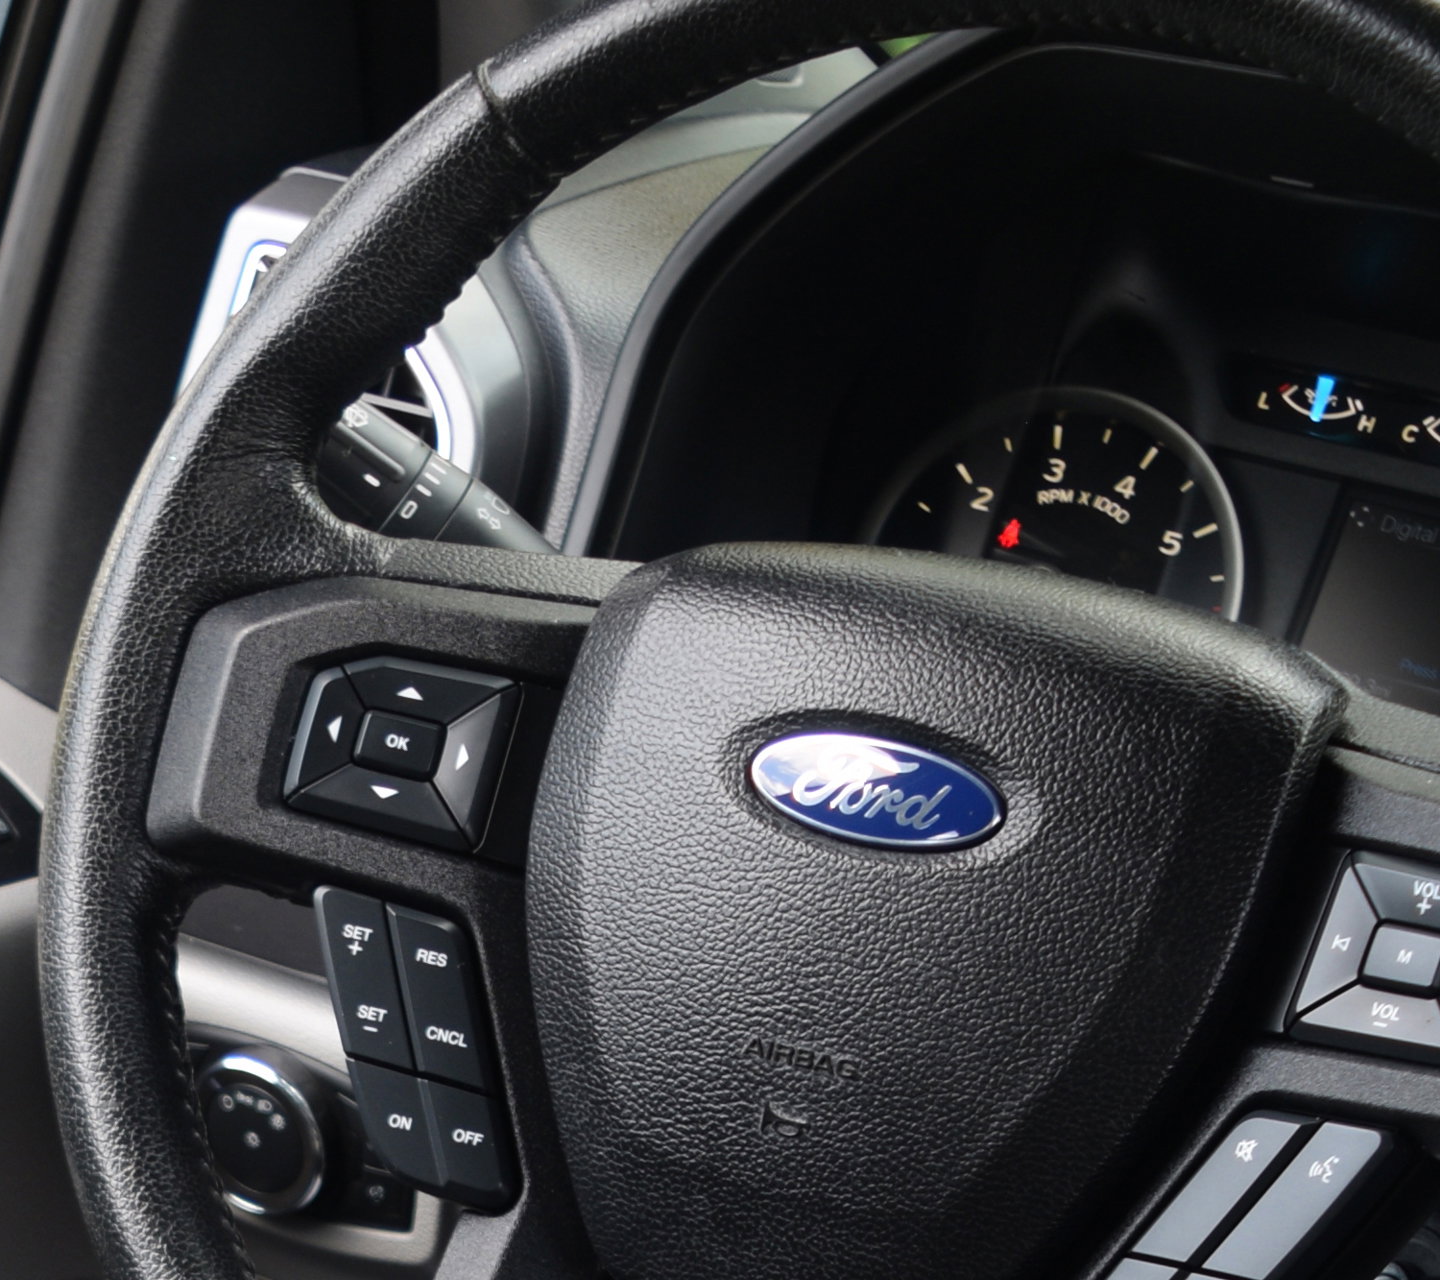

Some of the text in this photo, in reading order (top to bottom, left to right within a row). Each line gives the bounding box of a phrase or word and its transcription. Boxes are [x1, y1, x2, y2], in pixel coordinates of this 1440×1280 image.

[1357, 415, 1377, 434] H
[1401, 425, 1419, 444] C
[1042, 458, 1067, 483] 3
[1114, 475, 1137, 499] 4
[970, 487, 995, 512] 2
[1037, 488, 1074, 505] RPM
[1092, 496, 1131, 525] 1000
[1380, 513, 1440, 549] Digital
[1158, 530, 1184, 556] 5
[385, 733, 410, 752] OK
[791, 746, 954, 831] Ford
[341, 923, 374, 942] SET
[415, 948, 448, 968] RES
[1397, 948, 1413, 965] M
[356, 1003, 388, 1023] SET
[1370, 1002, 1401, 1022] VOL
[424, 1025, 469, 1048] CNCL
[741, 1035, 861, 1081] AIRBAG
[387, 1113, 413, 1132] ON
[451, 1128, 485, 1147] OFF
